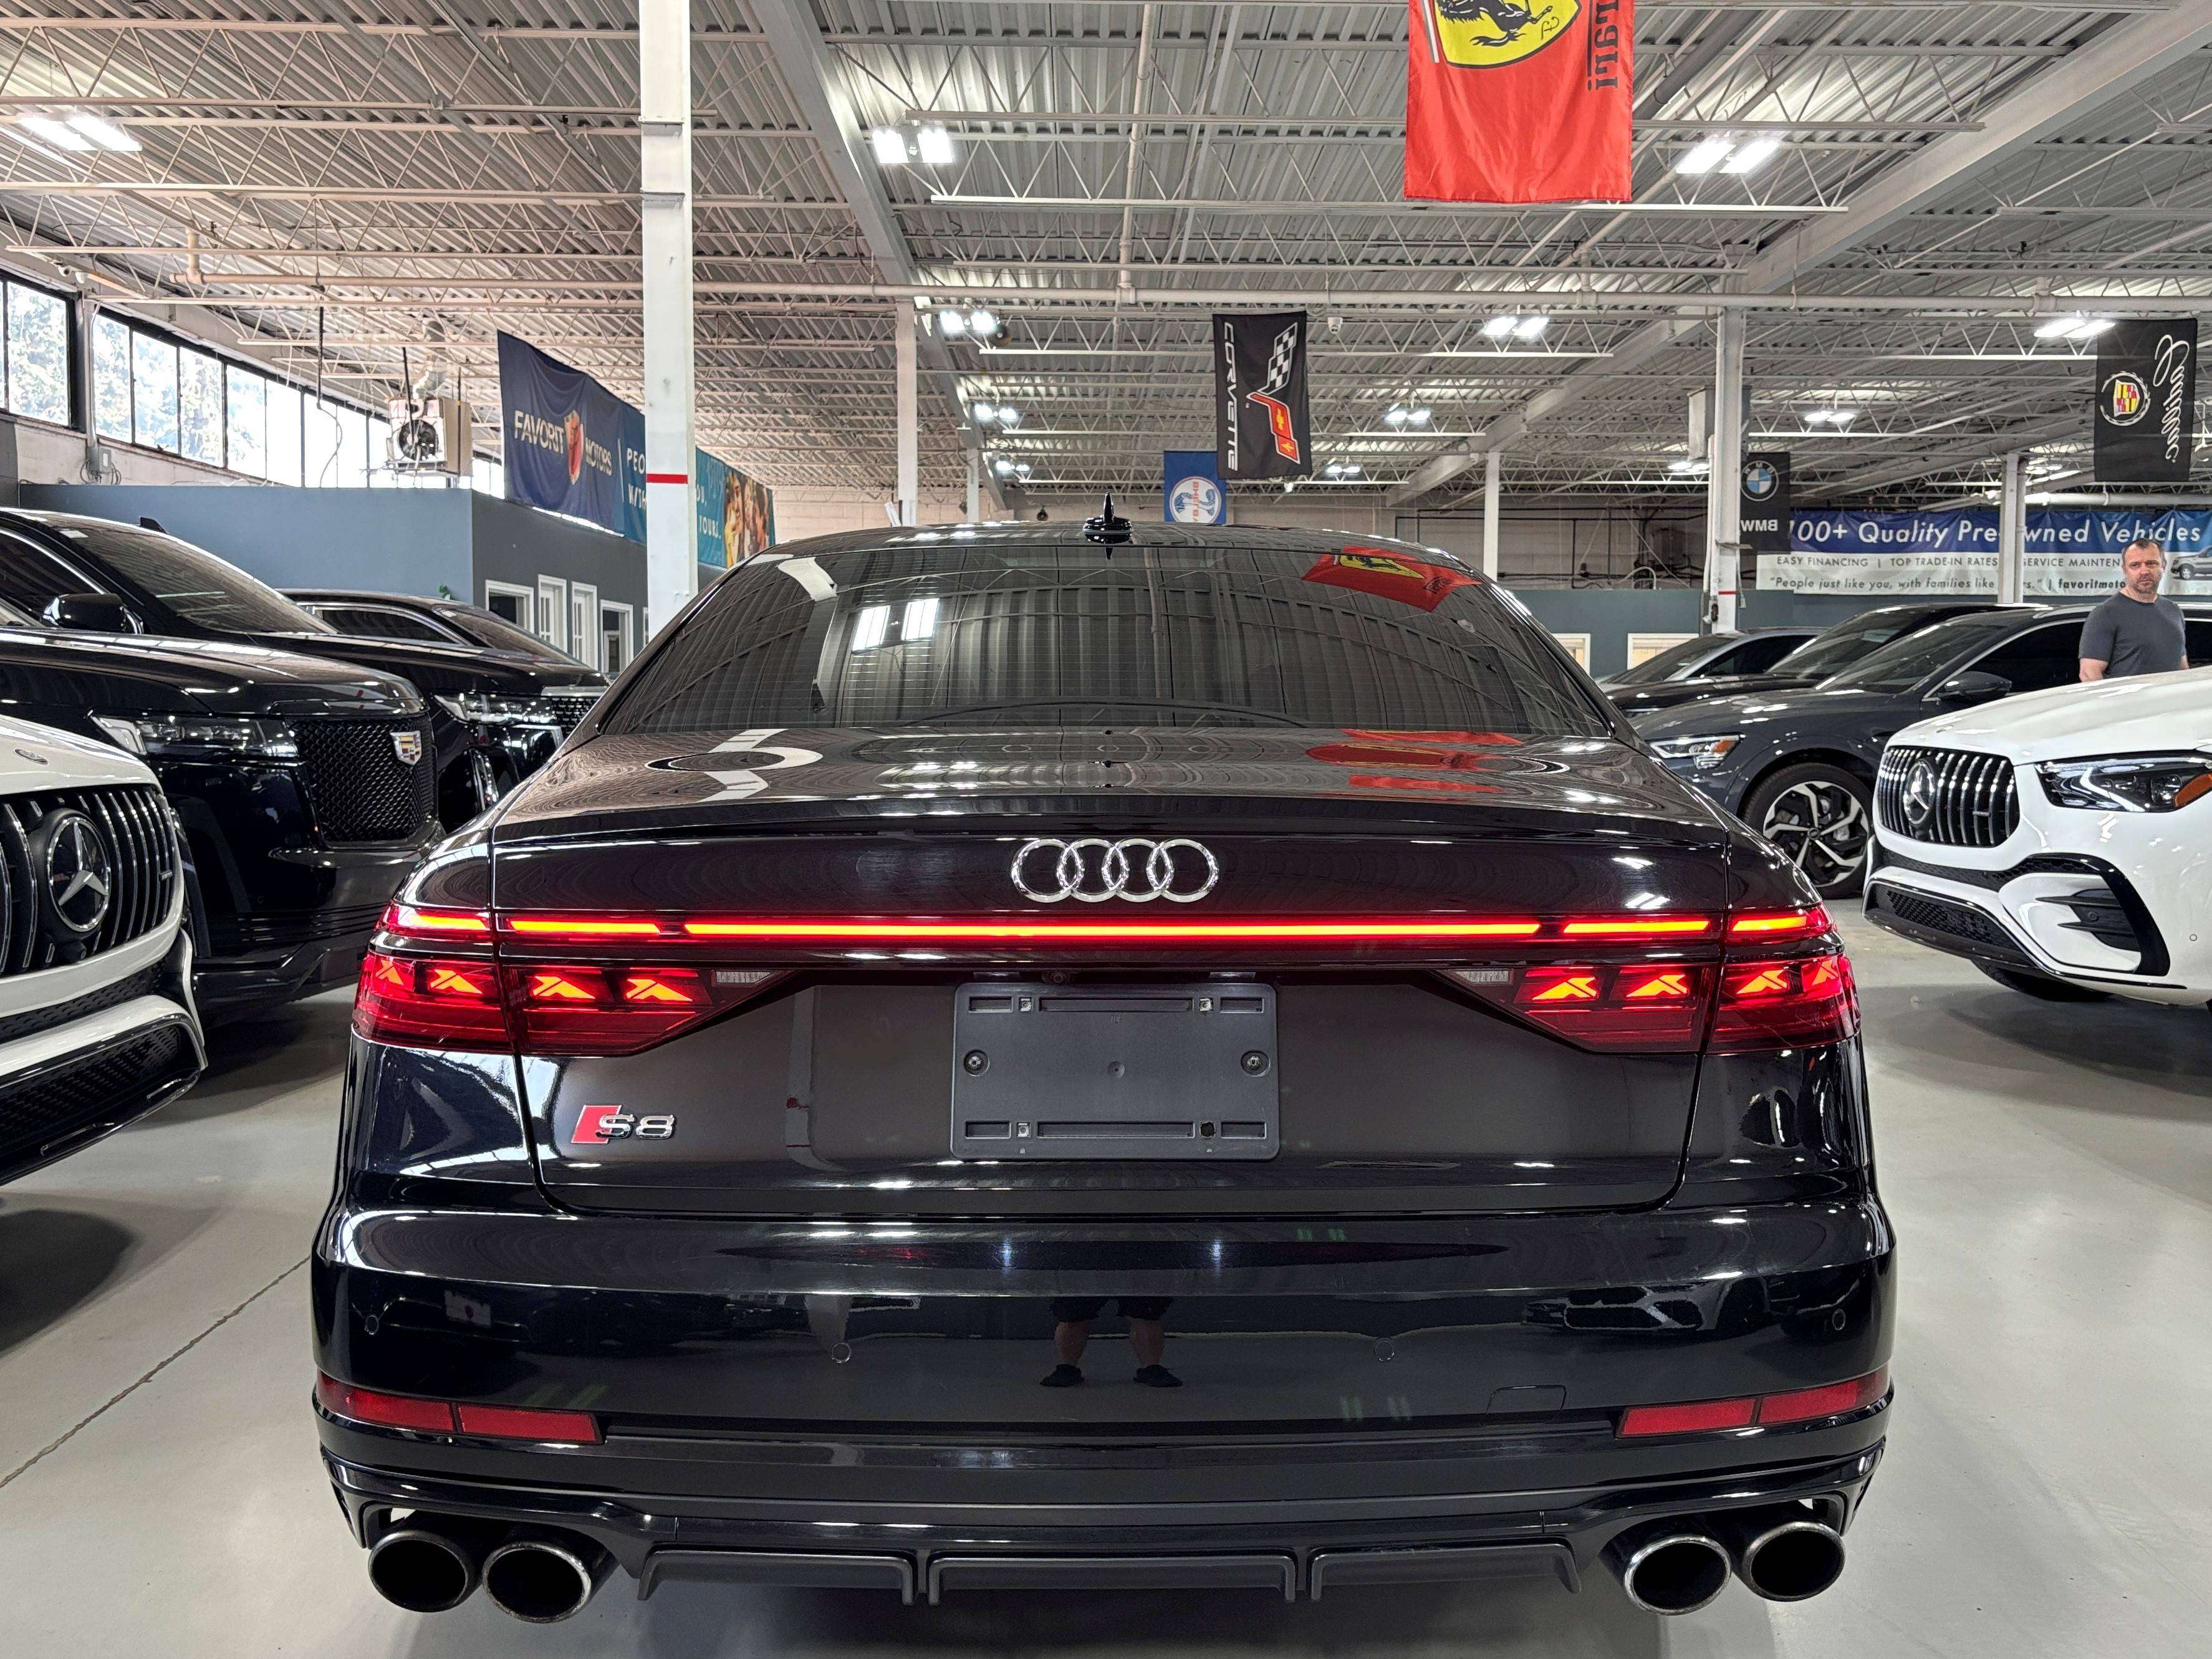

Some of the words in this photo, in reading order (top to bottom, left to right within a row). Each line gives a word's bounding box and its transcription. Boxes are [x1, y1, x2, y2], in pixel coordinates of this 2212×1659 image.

[1224, 321, 1238, 471] CORVETTE
[514, 410, 564, 454] FAVORIT
[585, 437, 612, 476] MOTORS
[627, 448, 646, 474] PEO
[696, 484, 707, 506] OU,
[1859, 519, 1949, 548] Quality
[2101, 517, 2201, 543] Vehicles
[1777, 555, 1803, 565] EASY
[1807, 556, 1868, 567] FINANCING
[1890, 557, 1912, 567] TOP
[1968, 557, 1998, 567] RATES
[2069, 558, 2120, 567] MAINTEN
[1819, 577, 1840, 590] just
[1844, 577, 1865, 589] like
[1869, 582, 1893, 590] you,
[1898, 579, 1921, 589] with
[1926, 579, 1971, 589] families
[1975, 579, 1994, 589] like
[595, 1113, 675, 1140] S8
